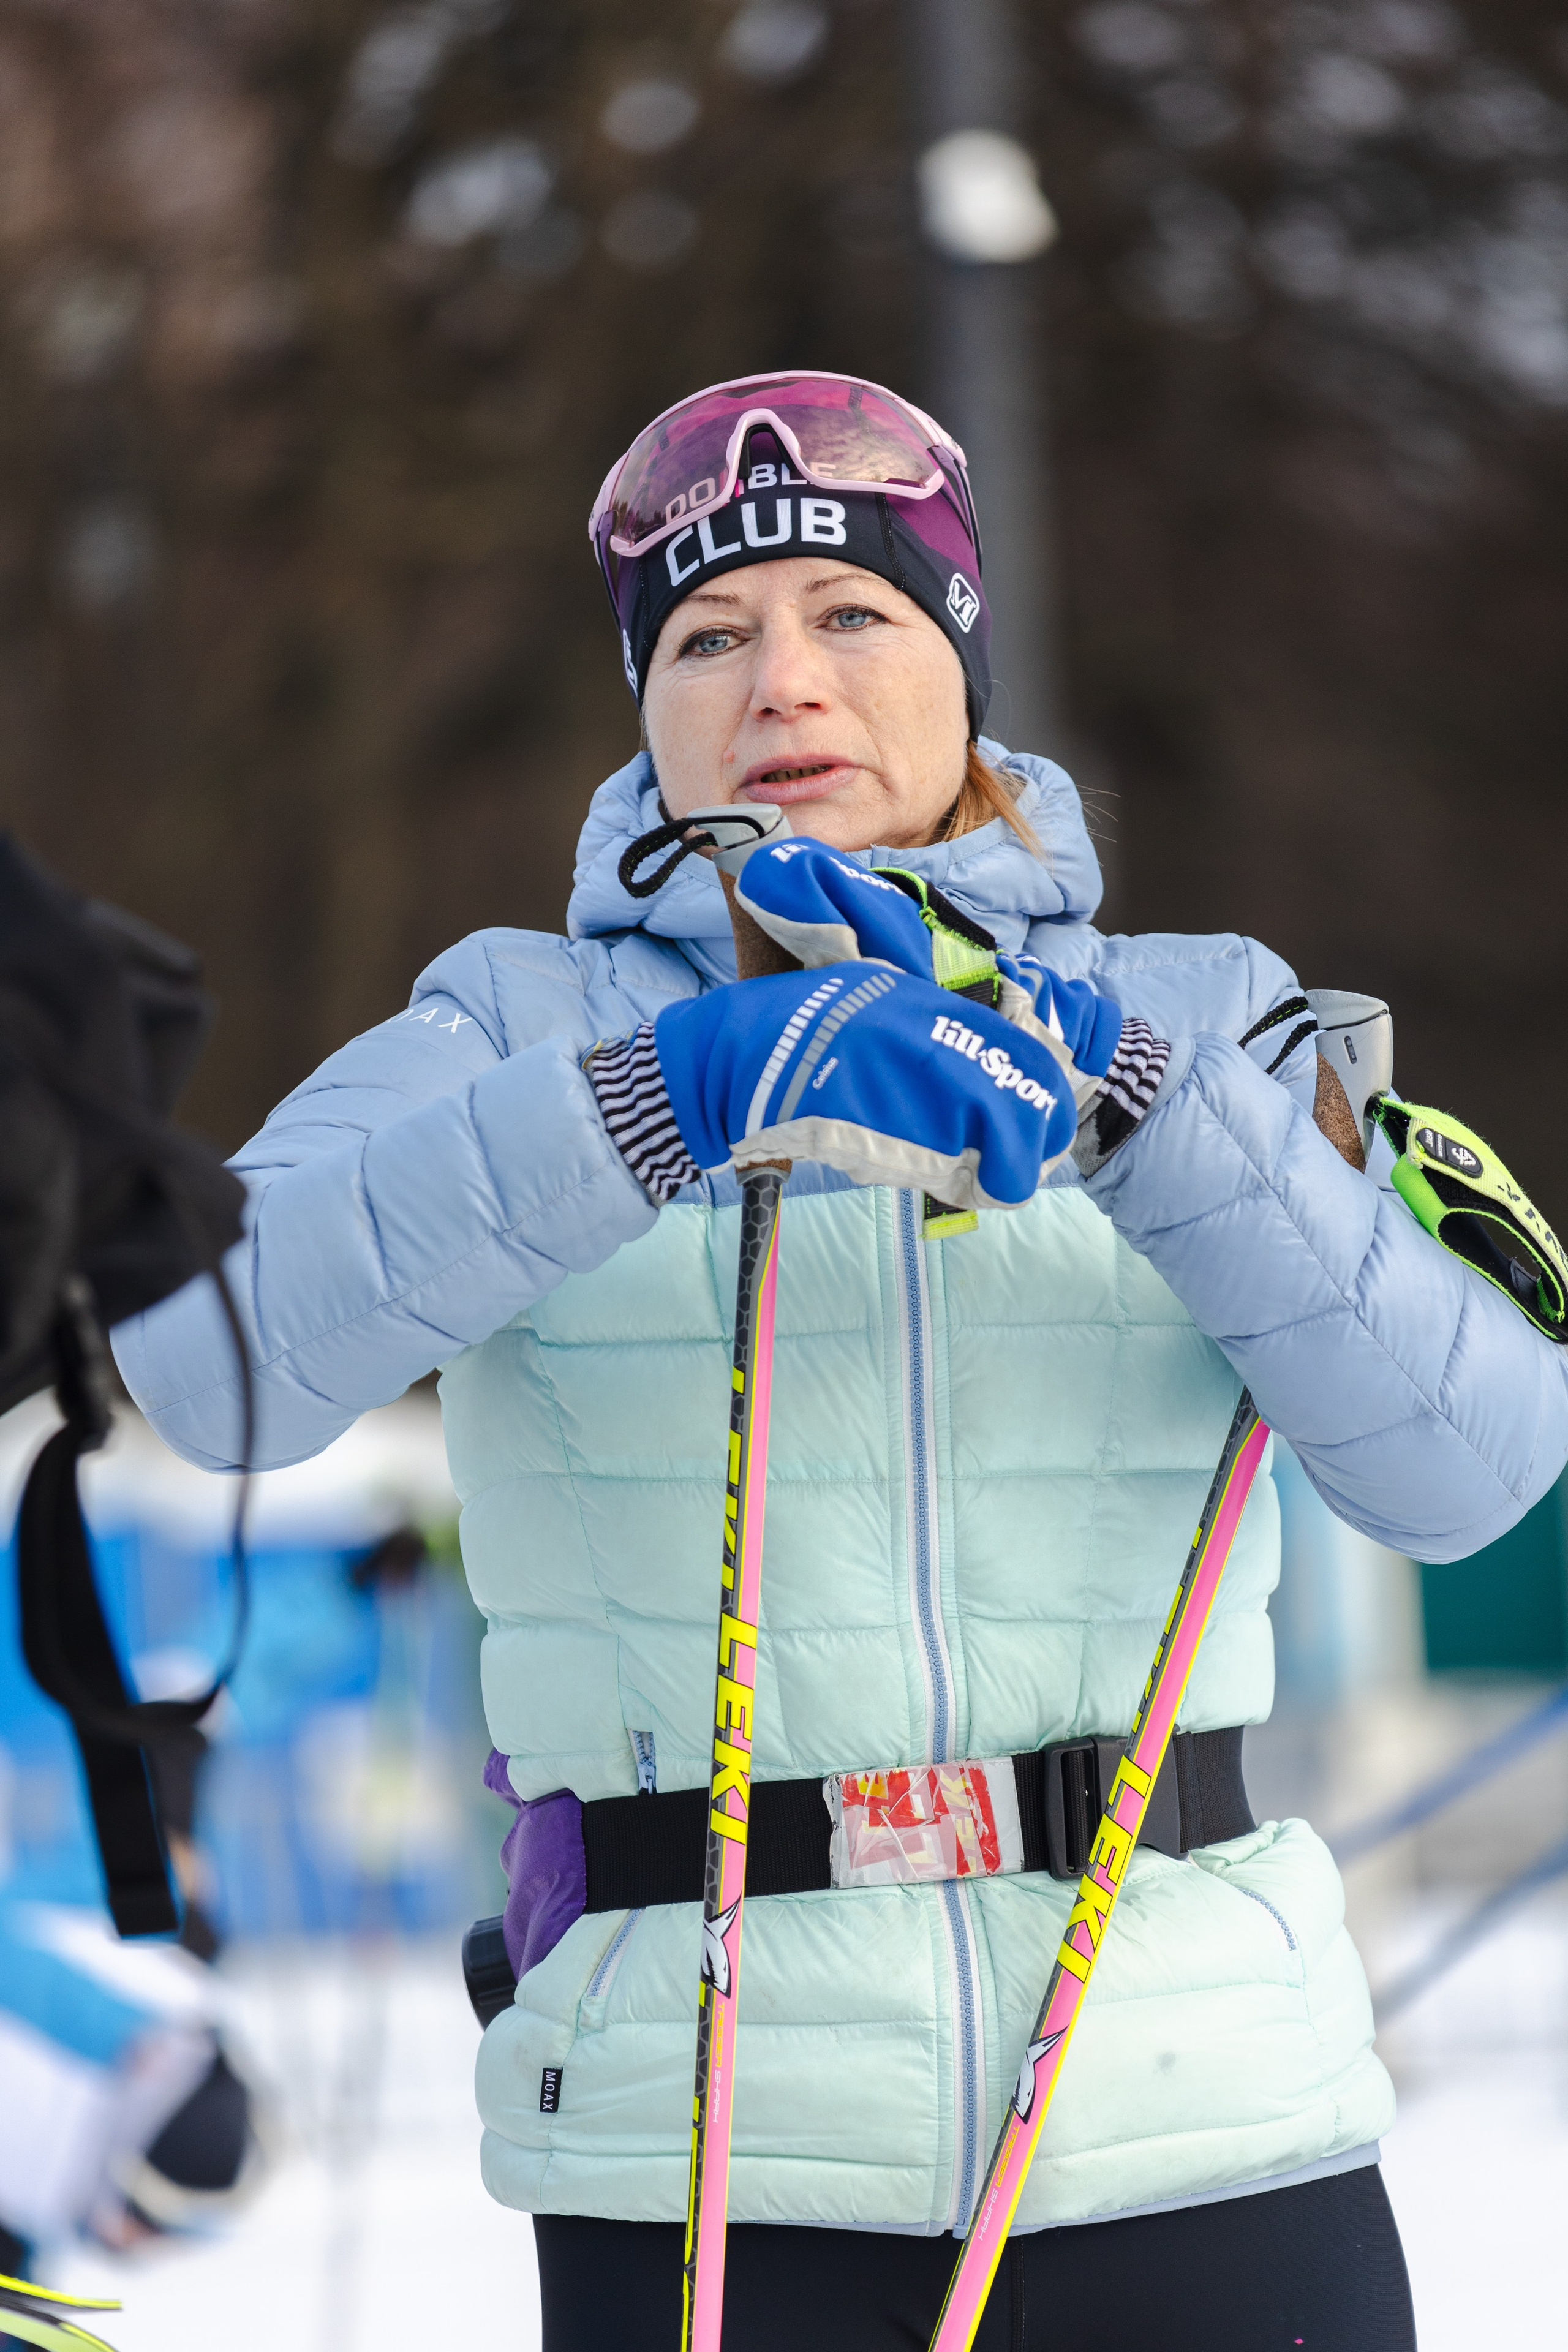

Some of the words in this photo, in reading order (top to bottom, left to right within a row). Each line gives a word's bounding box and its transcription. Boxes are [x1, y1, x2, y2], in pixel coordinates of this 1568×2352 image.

[665, 497, 848, 587] CLUB
[710, 1611, 758, 1845] LEKI
[1057, 1754, 1152, 1985] LEKI
[715, 2002, 725, 2068] TRIGGER
[542, 2071, 556, 2111] MOAX
[712, 2070, 722, 2124] SHARK
[995, 2125, 1020, 2187] TRIGGER
[978, 2188, 998, 2241] SHARK
